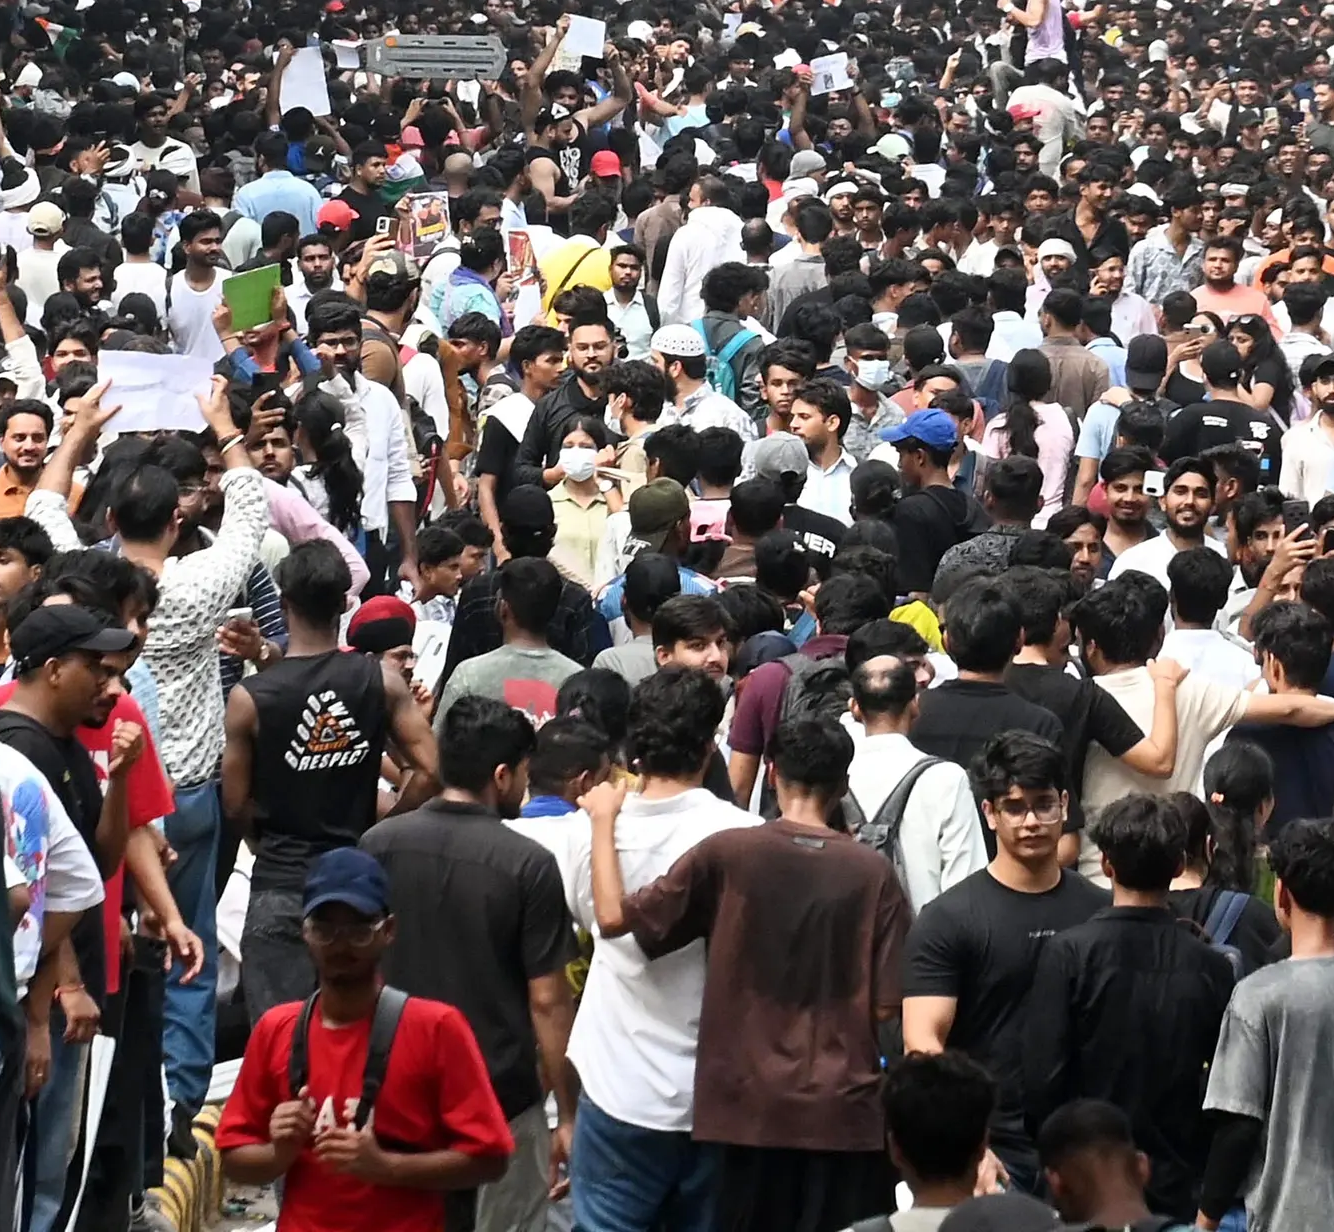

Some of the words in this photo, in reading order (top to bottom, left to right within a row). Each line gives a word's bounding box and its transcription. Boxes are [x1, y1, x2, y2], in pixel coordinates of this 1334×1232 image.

[284, 694, 321, 769] BLOOD
[319, 689, 369, 750] SWEAT
[298, 748, 369, 772] RESPECT
